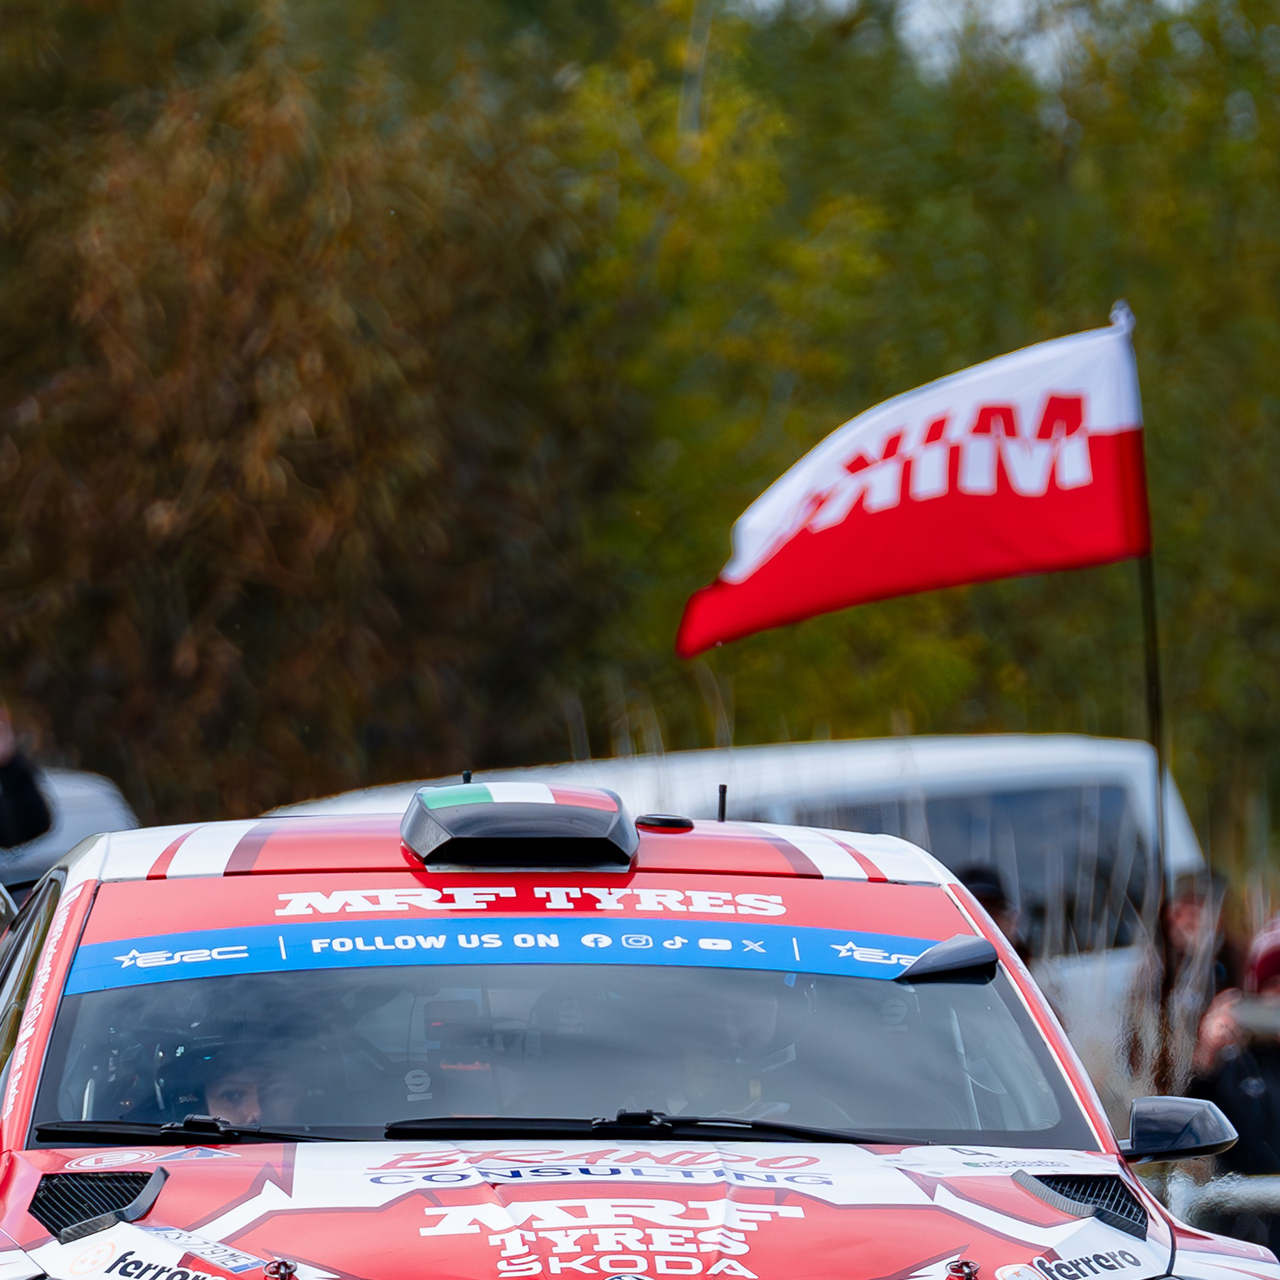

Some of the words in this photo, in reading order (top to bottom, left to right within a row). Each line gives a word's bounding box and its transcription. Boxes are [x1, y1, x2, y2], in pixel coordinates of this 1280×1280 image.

[274, 887, 517, 916] MRF
[545, 887, 786, 916] TYRES
[310, 934, 448, 954] FOLLOW
[457, 934, 504, 950] US
[512, 933, 560, 950] ON
[136, 945, 249, 968] ERC
[852, 947, 920, 967] ER
[368, 1149, 821, 1169] BRANDO
[370, 1166, 834, 1185] CONSULTING
[419, 1199, 805, 1235] MRF
[488, 1228, 750, 1257] TYRES
